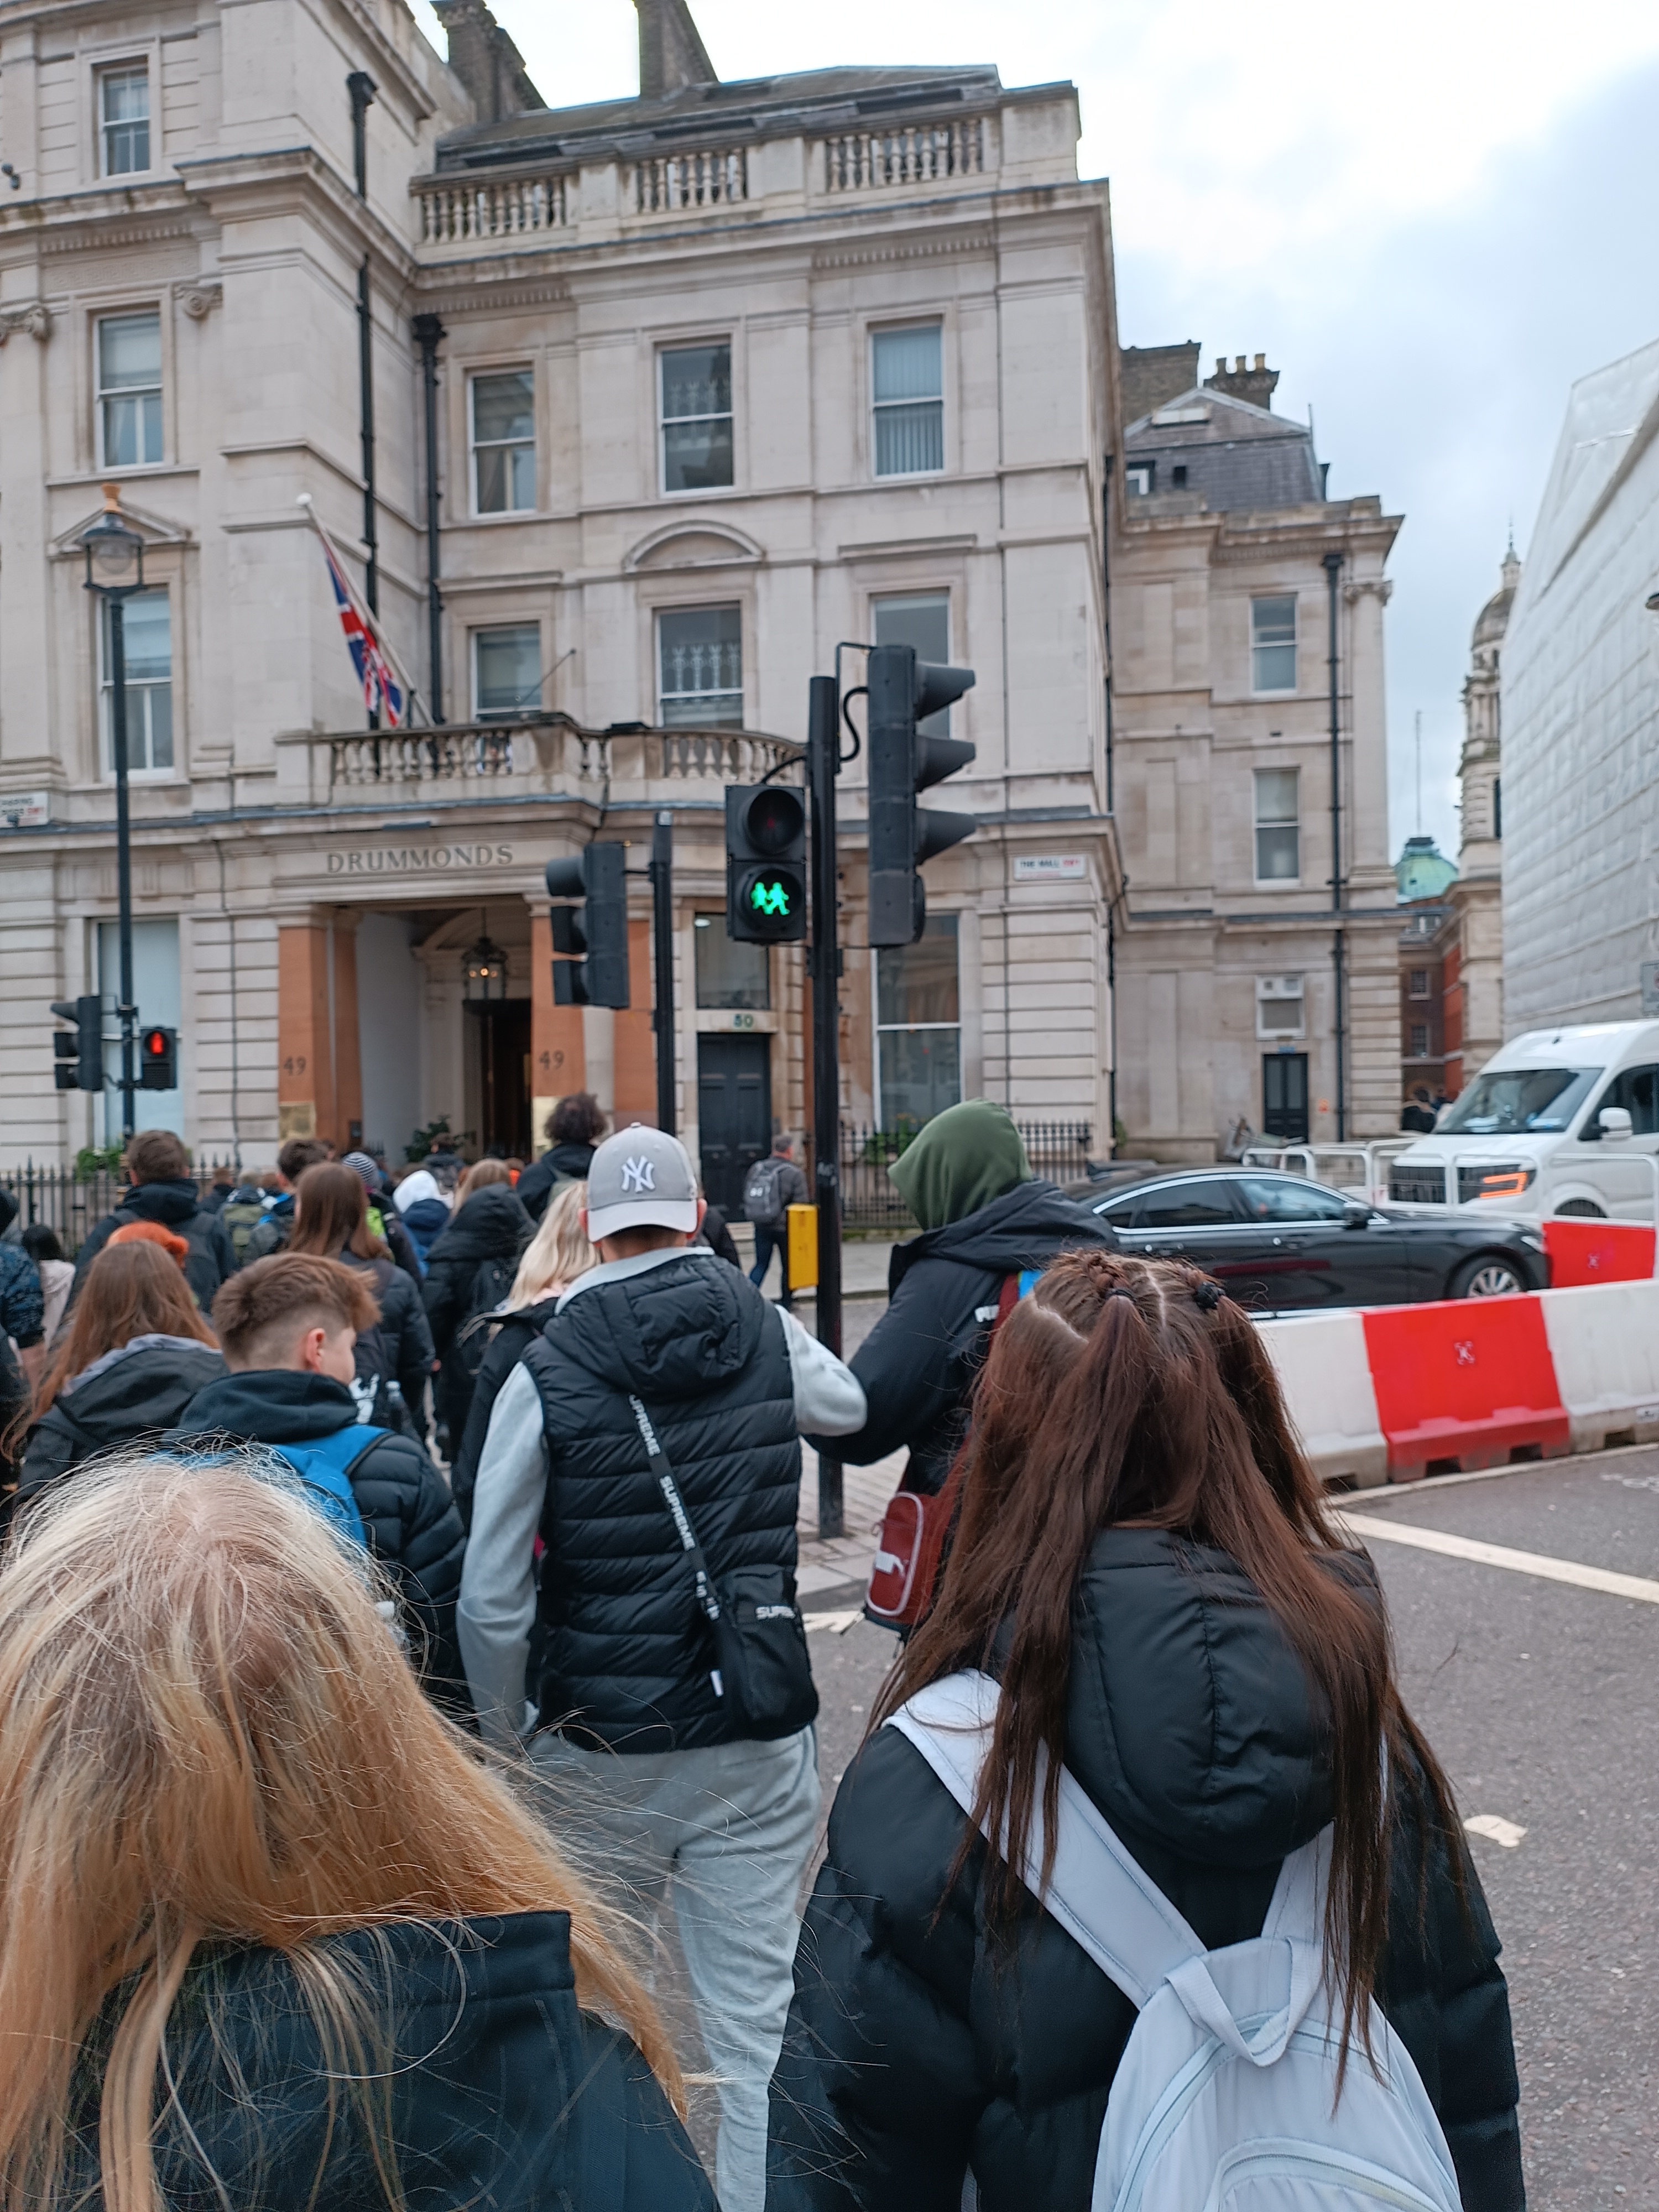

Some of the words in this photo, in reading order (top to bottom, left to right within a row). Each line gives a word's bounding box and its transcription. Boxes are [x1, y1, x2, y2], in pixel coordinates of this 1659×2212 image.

[326, 843, 513, 873] DRUMMONDS
[734, 1013, 754, 1028] 50
[283, 1057, 306, 1076] 49
[539, 1051, 565, 1070] 49
[621, 1155, 656, 1193] NY
[659, 1475, 696, 1551] SUPREME
